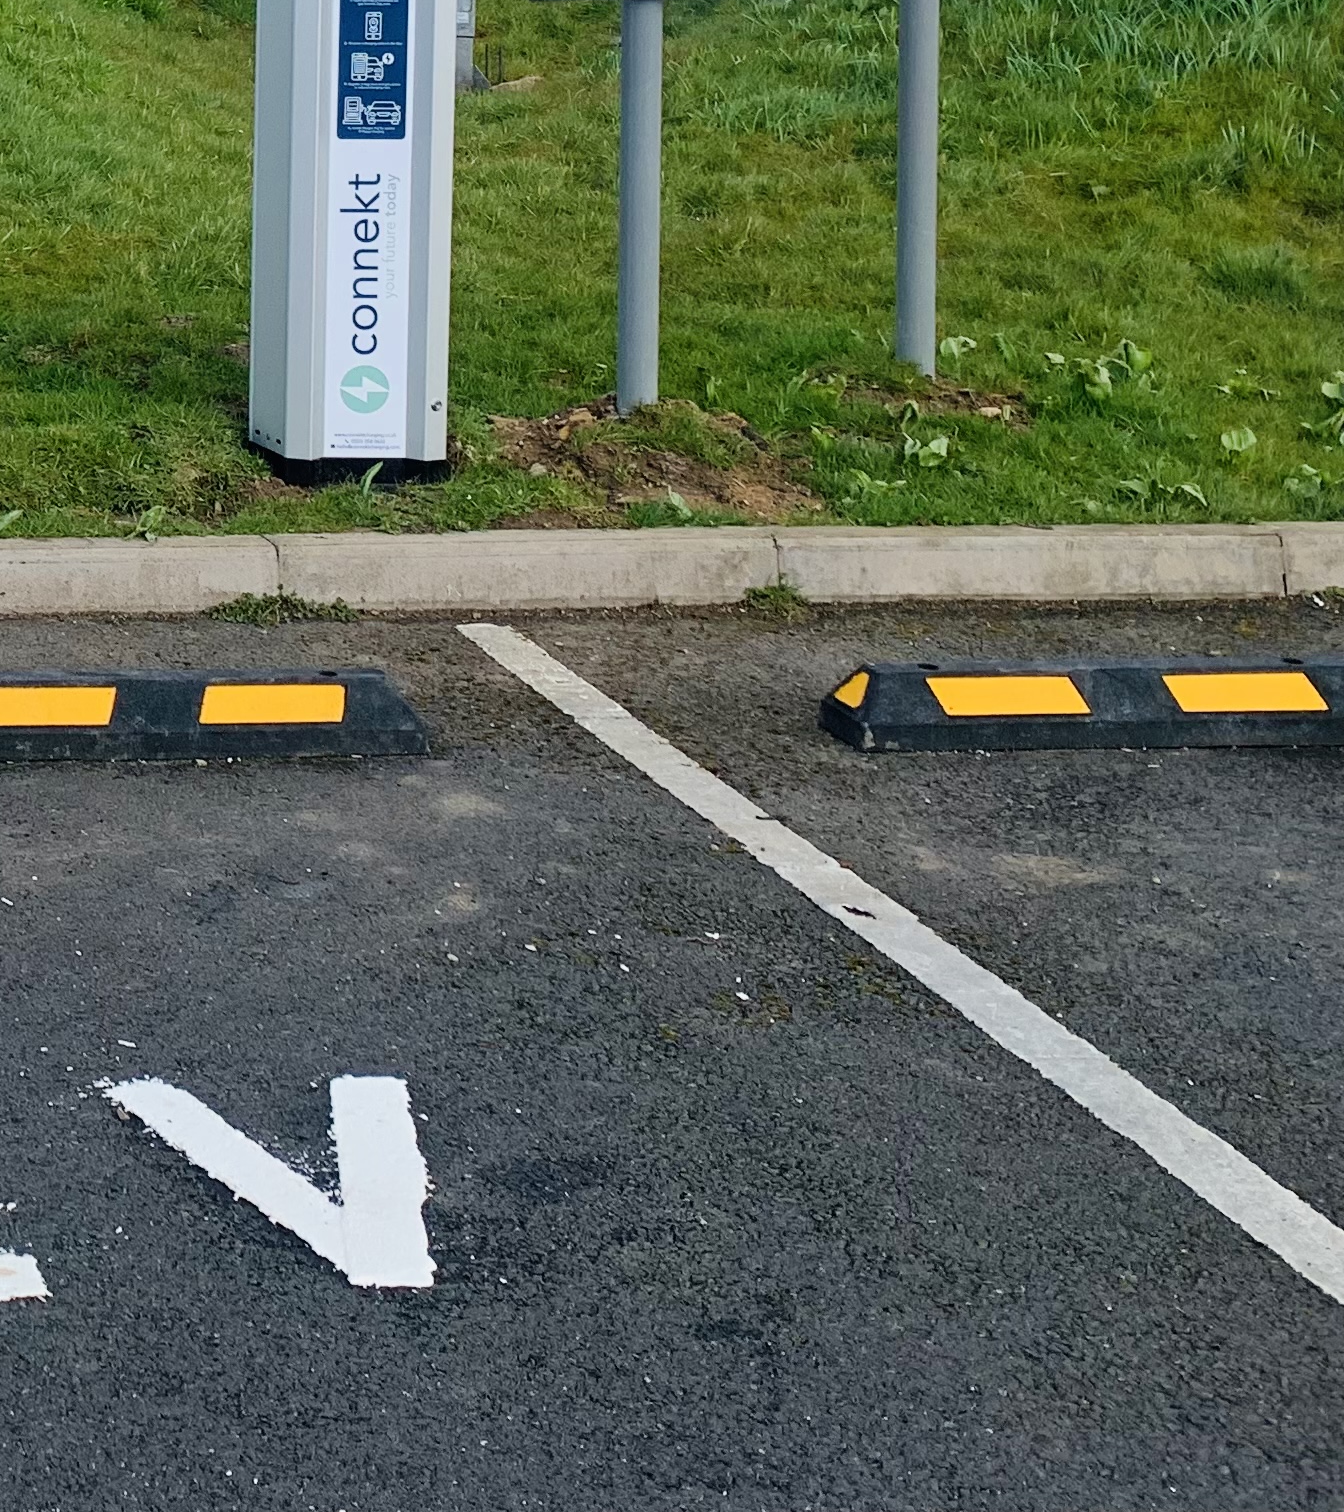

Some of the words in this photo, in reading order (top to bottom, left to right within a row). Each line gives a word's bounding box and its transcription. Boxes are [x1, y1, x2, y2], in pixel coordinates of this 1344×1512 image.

[383, 173, 401, 216] today
[339, 173, 381, 355] connekt
[381, 221, 396, 264] future
[385, 268, 399, 299] your
